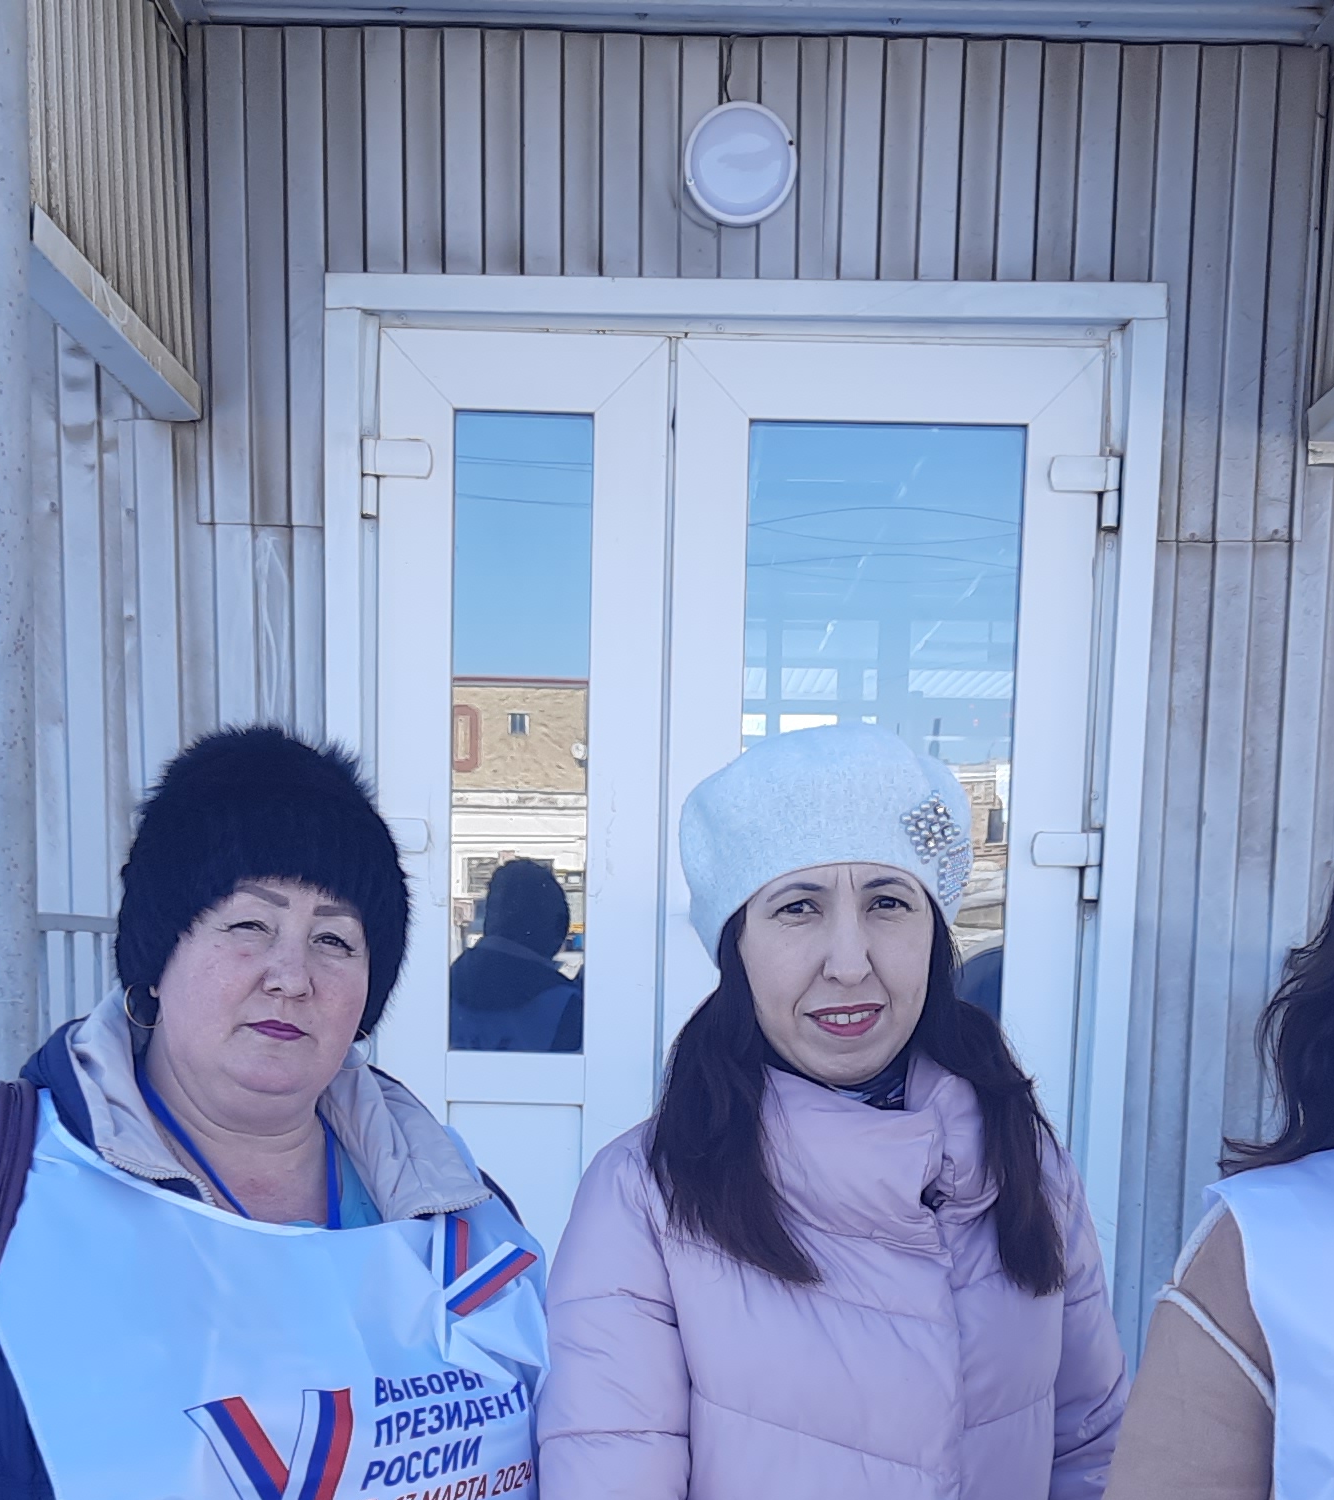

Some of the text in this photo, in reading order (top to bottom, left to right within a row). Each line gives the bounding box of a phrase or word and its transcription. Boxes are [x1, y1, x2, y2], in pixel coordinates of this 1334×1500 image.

[374, 1368, 485, 1408] ВЫБОРЫ
[359, 1434, 483, 1492] РОССИИ
[490, 1458, 533, 1497] 2024
